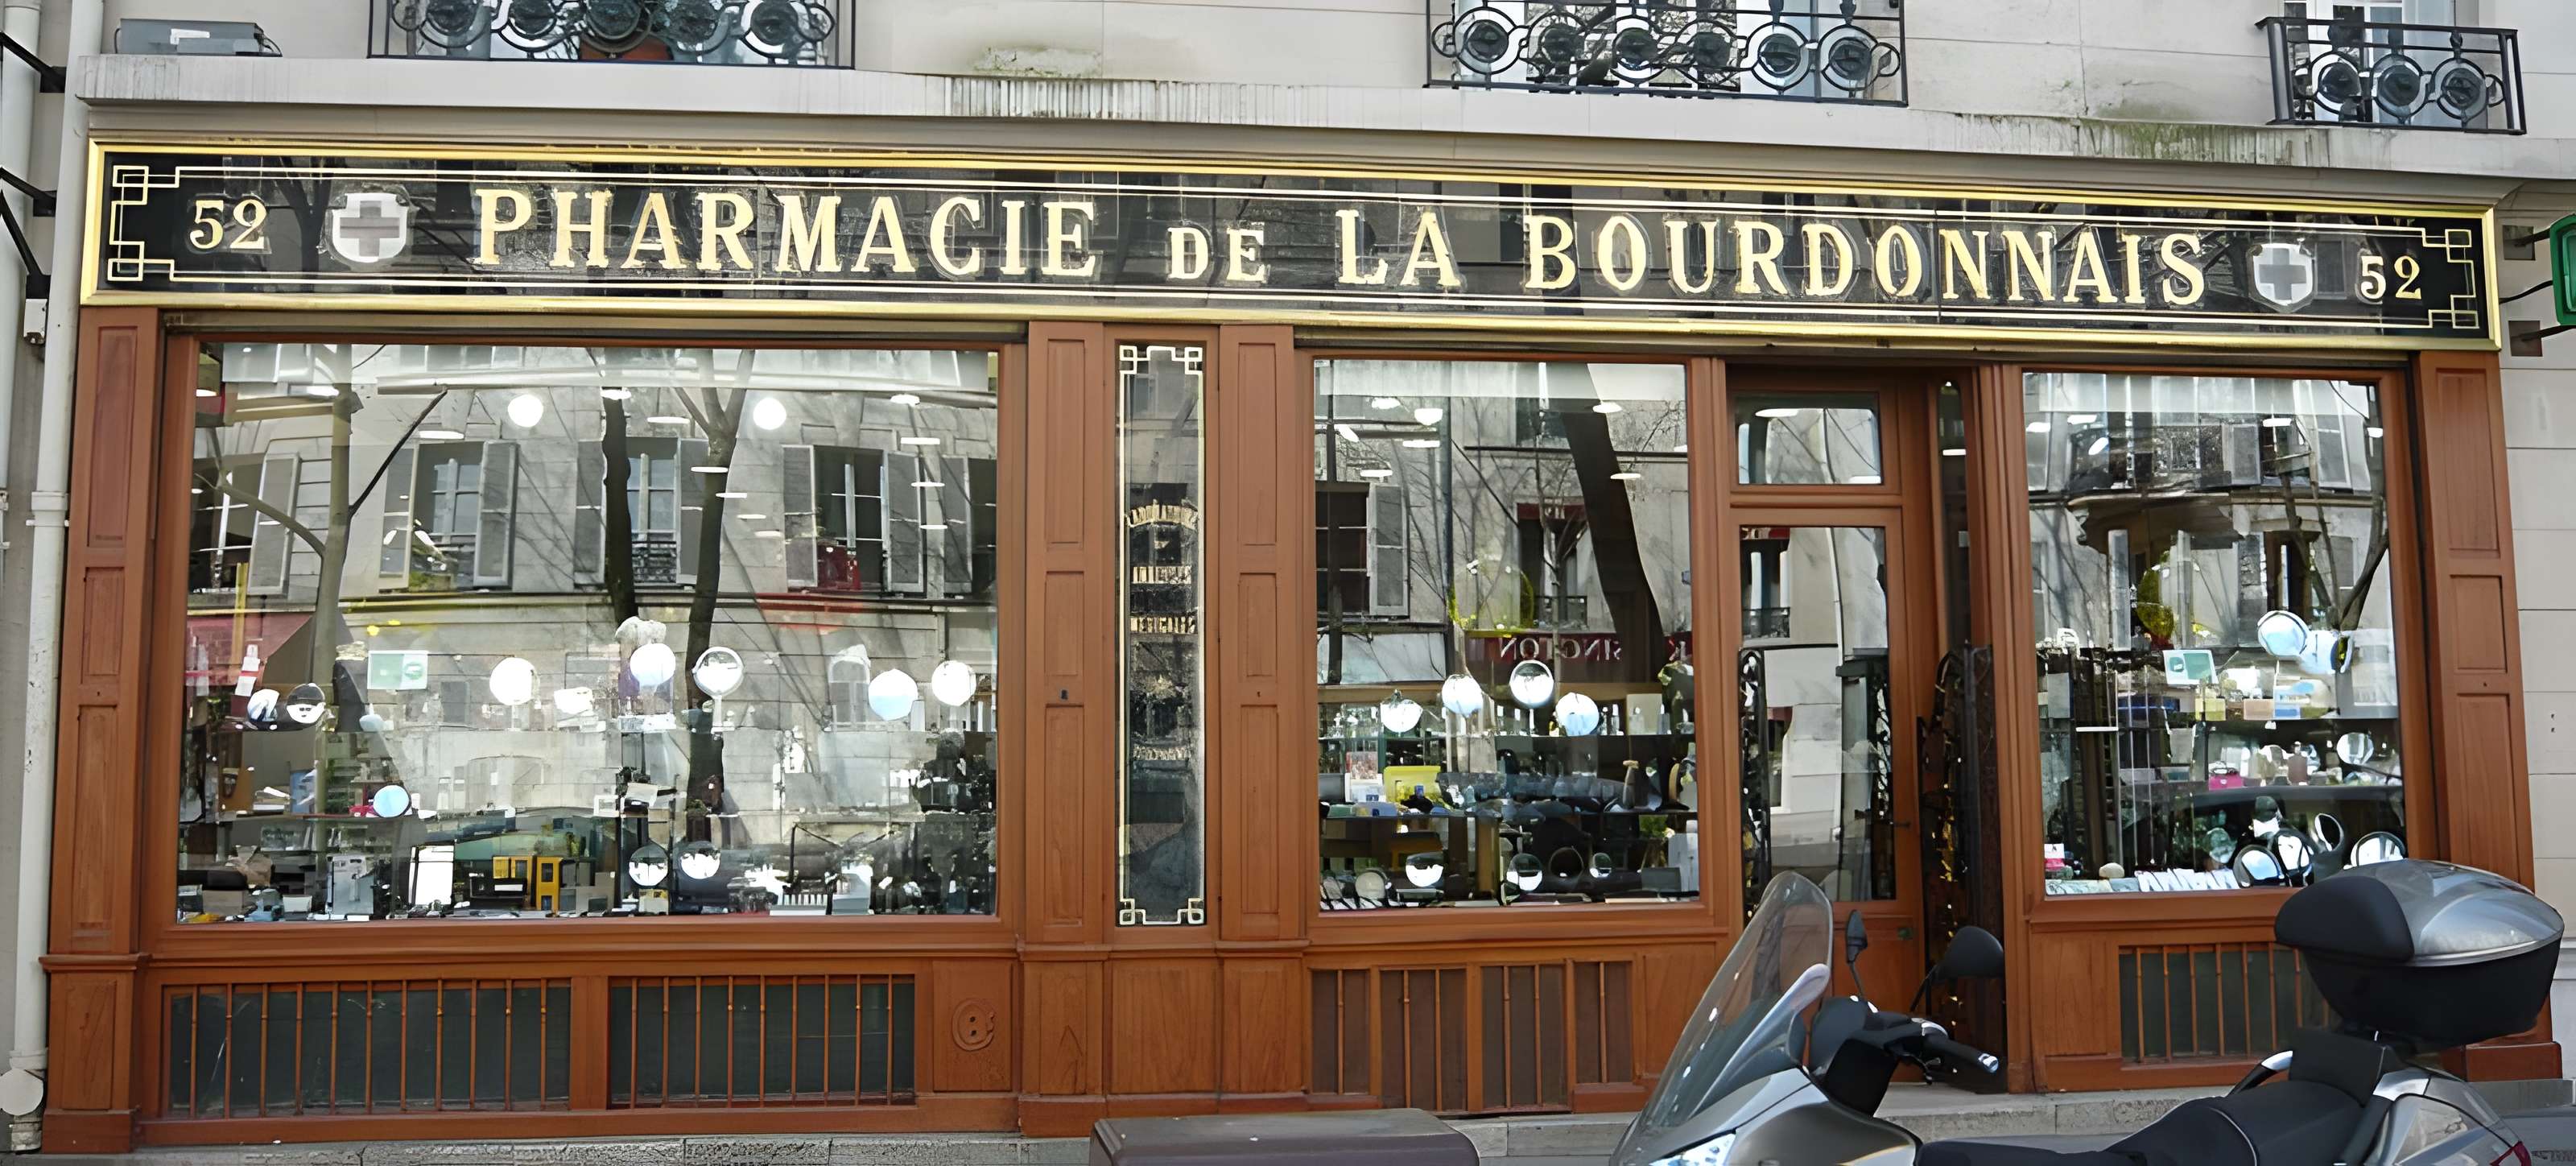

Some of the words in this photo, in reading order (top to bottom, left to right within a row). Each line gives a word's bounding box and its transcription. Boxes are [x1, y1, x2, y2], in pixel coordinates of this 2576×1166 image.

[189, 198, 267, 250] 52
[472, 187, 1097, 278] PHARMACIE
[1166, 225, 1265, 282] DE
[1335, 208, 1463, 287] LA
[1525, 213, 2205, 306] BOURDONNAIS
[2359, 254, 2422, 301] 52
